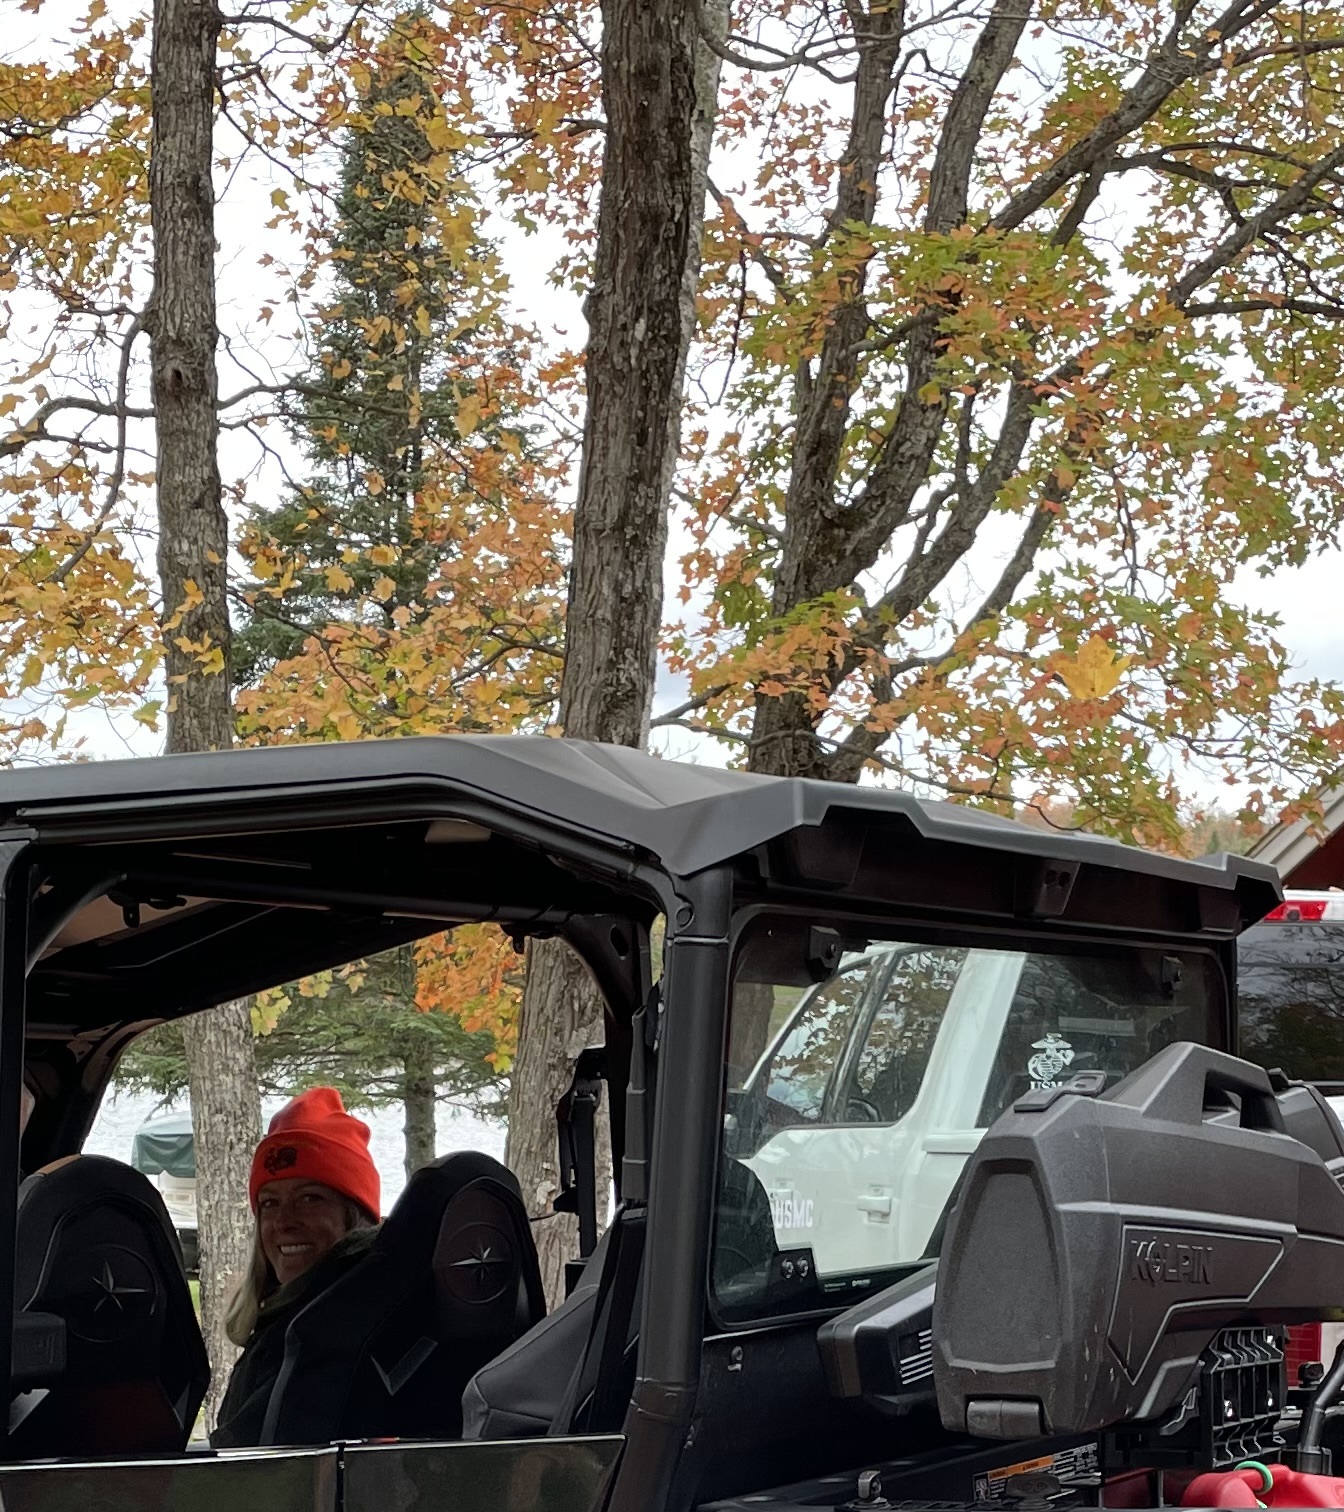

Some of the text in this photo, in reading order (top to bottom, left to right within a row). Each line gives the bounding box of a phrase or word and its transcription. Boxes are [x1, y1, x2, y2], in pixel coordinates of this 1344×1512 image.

[1030, 1080, 1063, 1090] USM
[774, 1199, 814, 1229] USMC
[1130, 1236, 1213, 1287] KOLPIN
